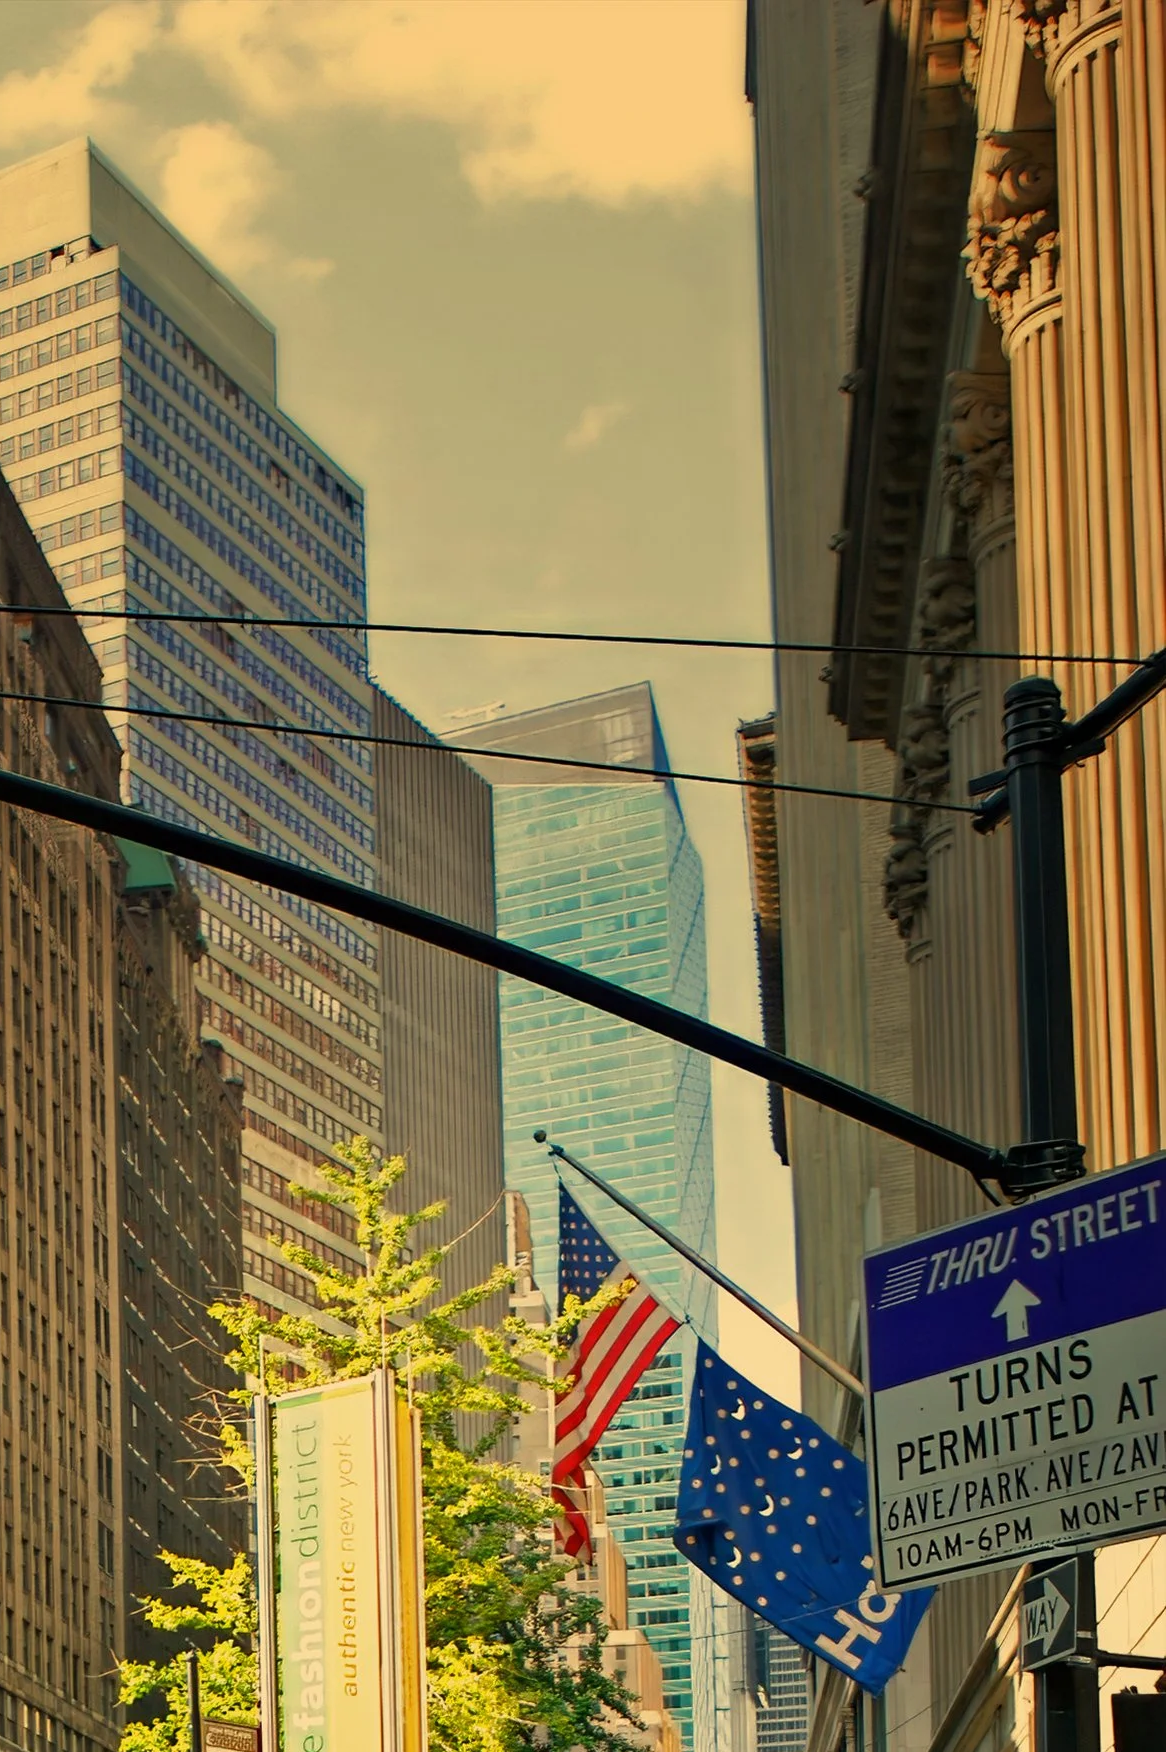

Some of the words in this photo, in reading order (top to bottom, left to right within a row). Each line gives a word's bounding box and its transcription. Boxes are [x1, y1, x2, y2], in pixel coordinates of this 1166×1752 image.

[926, 1226, 1018, 1295] THRU
[1030, 1180, 1161, 1260] STREET
[949, 1339, 1092, 1412] TURNS
[897, 1393, 1094, 1481] PERMITTED
[1117, 1374, 1158, 1424] AT
[333, 1433, 358, 1490] york
[338, 1496, 356, 1553] new
[897, 1516, 1034, 1570] 10AM-6PM
[337, 1561, 358, 1697] authentic
[1025, 1596, 1059, 1640] WAY
